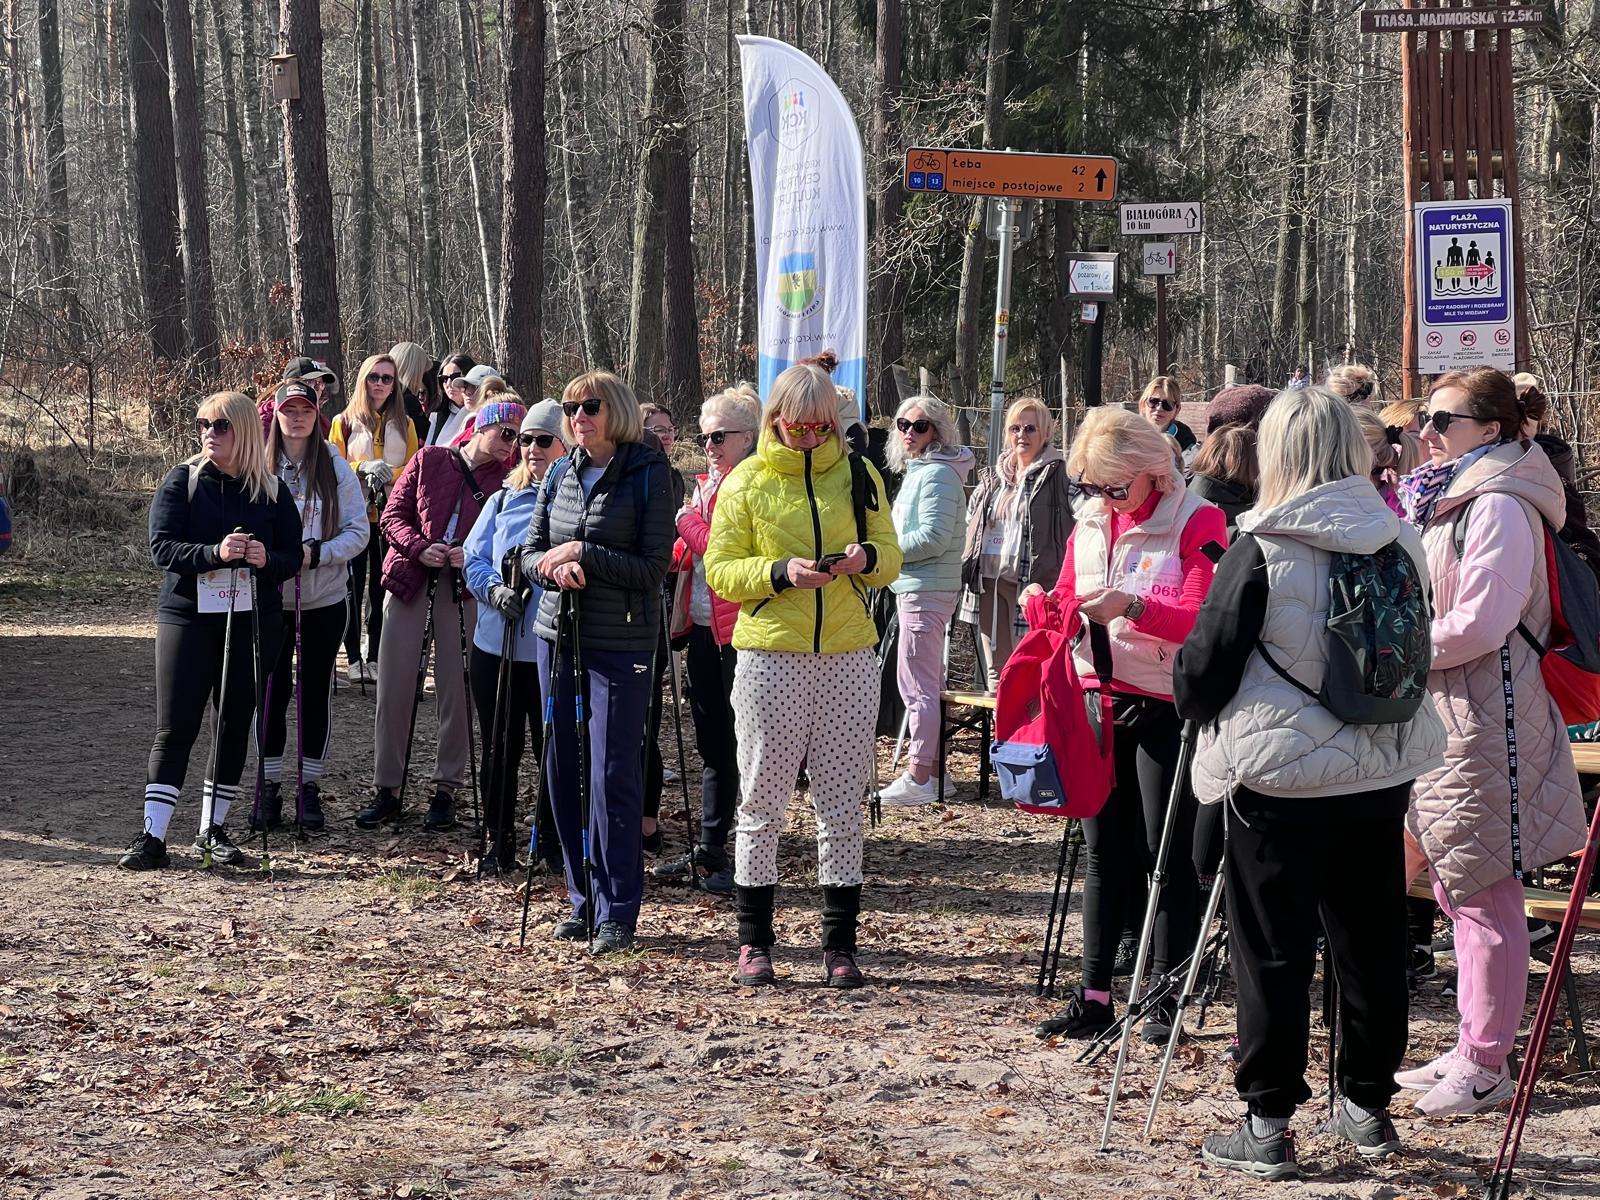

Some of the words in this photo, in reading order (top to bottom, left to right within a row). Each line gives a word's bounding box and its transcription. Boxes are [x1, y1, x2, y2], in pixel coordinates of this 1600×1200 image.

[1374, 14, 1414, 28] TRASA
[952, 157, 982, 169] Łeba
[1072, 166, 1086, 176] 42
[952, 177, 996, 190] miejsce
[1002, 181, 1063, 192] postojowe
[1078, 182, 1084, 192] 2
[1126, 206, 1182, 220] BIAŁOGÓRA
[1450, 212, 1478, 221] PLAŻA
[1126, 222, 1136, 230] 10
[1138, 221, 1150, 230] km
[1429, 222, 1500, 230] NATURYSTYCZNA
[1080, 262, 1098, 270] Dojazd
[1090, 281, 1094, 290] 1
[1152, 584, 1178, 598] 065
